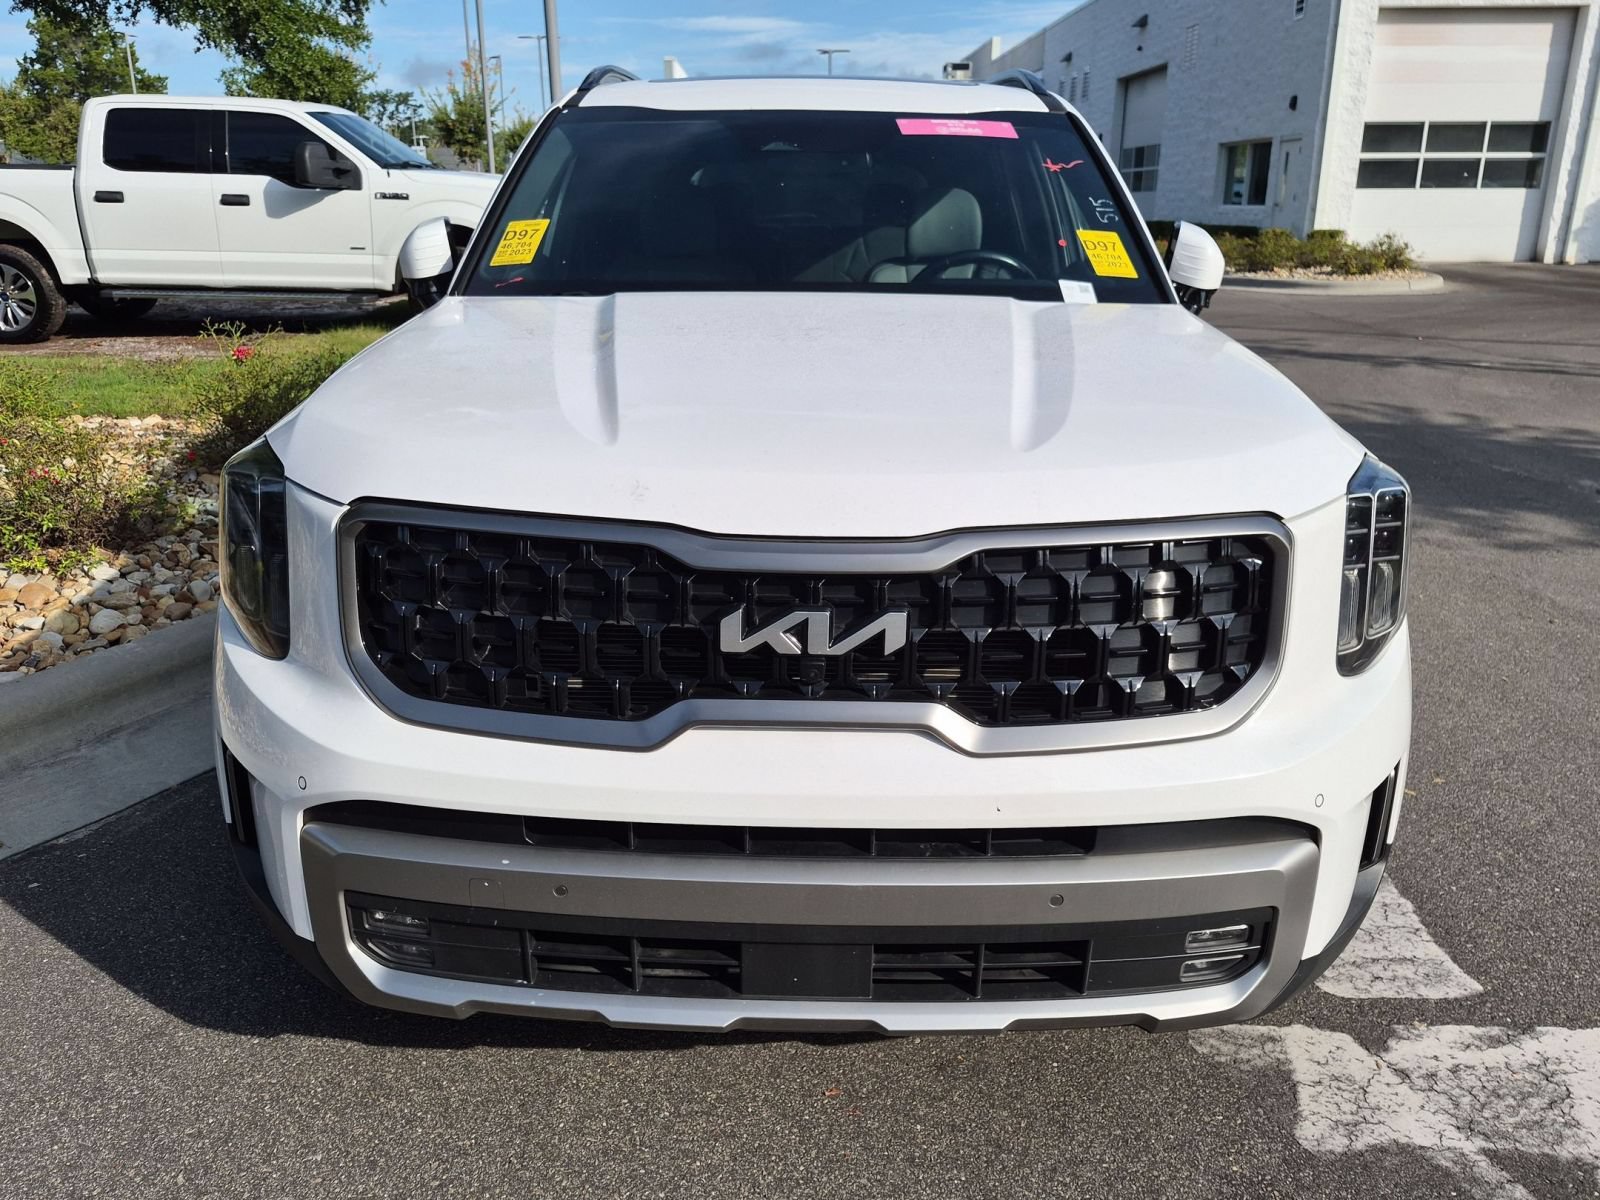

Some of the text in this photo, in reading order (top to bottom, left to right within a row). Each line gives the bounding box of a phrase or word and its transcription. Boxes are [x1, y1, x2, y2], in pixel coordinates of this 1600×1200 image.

[503, 228, 540, 241] D97
[1083, 240, 1117, 252] D97
[720, 608, 907, 656] KIA
